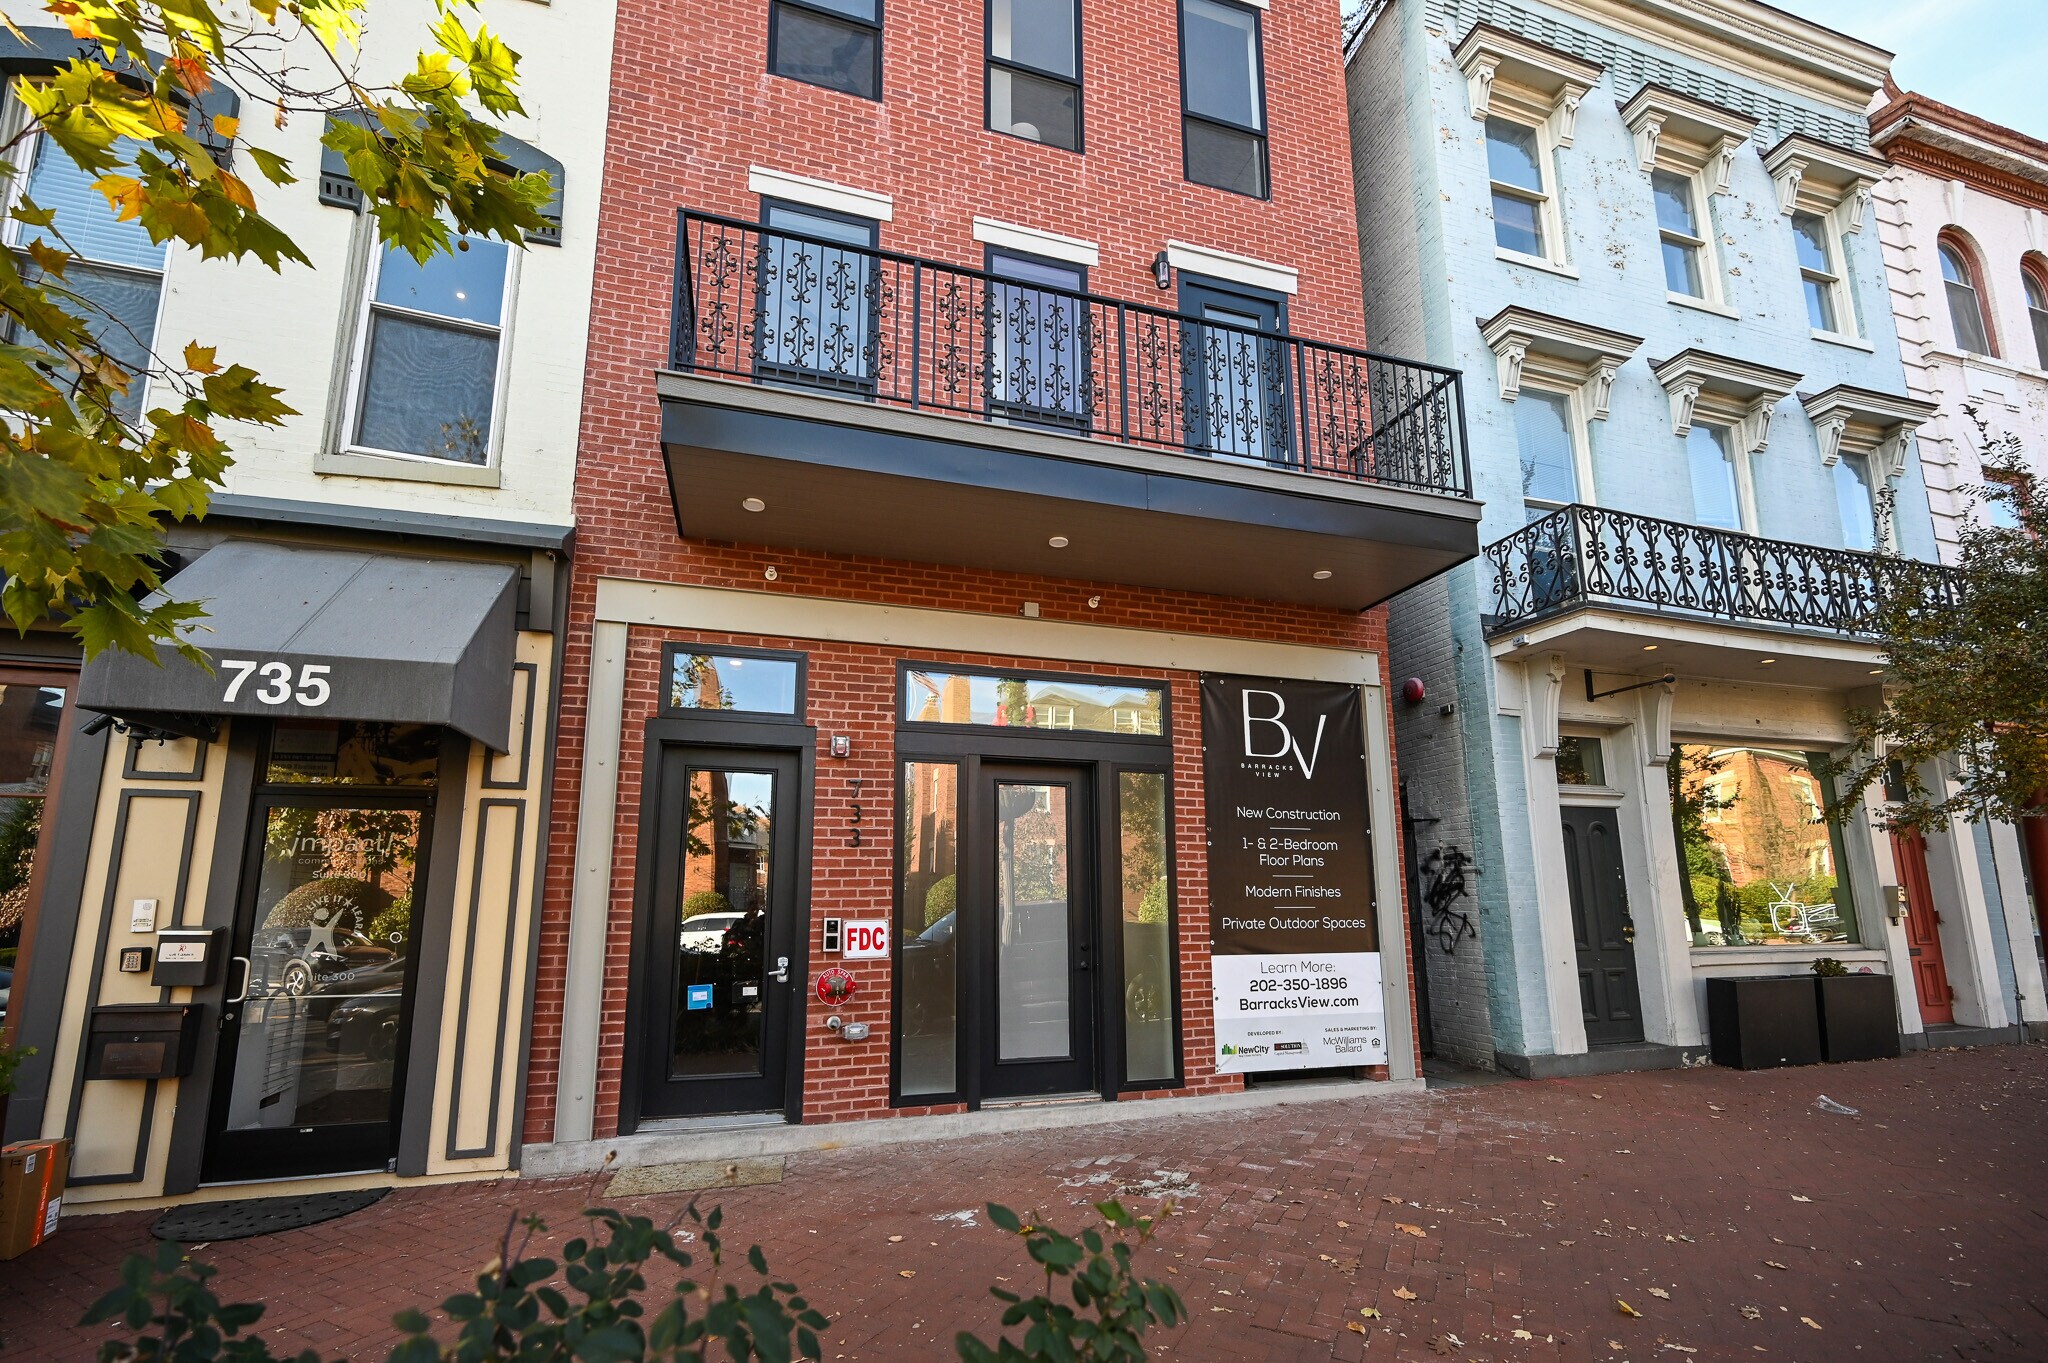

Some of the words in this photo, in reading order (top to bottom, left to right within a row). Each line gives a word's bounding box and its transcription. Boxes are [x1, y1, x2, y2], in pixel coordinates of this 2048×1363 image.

[221, 660, 331, 707] 735
[1242, 689, 1327, 780] BV
[1241, 763, 1293, 771] BARRACKS
[1236, 806, 1263, 819] New
[1266, 807, 1341, 821] Construction
[1242, 837, 1253, 849] 1-
[1257, 837, 1266, 850] &
[1269, 838, 1338, 851] 2-Bedroom
[1259, 854, 1289, 866] Floor
[1292, 855, 1325, 867] Plans
[1245, 885, 1292, 898] Modern
[1295, 885, 1342, 898] Finishes
[306, 895, 330, 911] LIVE
[333, 895, 344, 903] IT
[1222, 917, 1266, 930] Private
[1269, 917, 1320, 929] Outdoor
[1322, 917, 1366, 932] Spaces
[847, 927, 885, 951] FDC
[822, 969, 835, 979] AUTO
[1260, 961, 1297, 974] Learn
[1300, 961, 1336, 973] More:
[1249, 977, 1348, 992] 202-350-1896
[1239, 996, 1359, 1011] BarracksView.com
[1322, 1036, 1367, 1046] McWilliams
[1238, 1045, 1270, 1054] NewCity
[1335, 1043, 1363, 1054] Ballard
